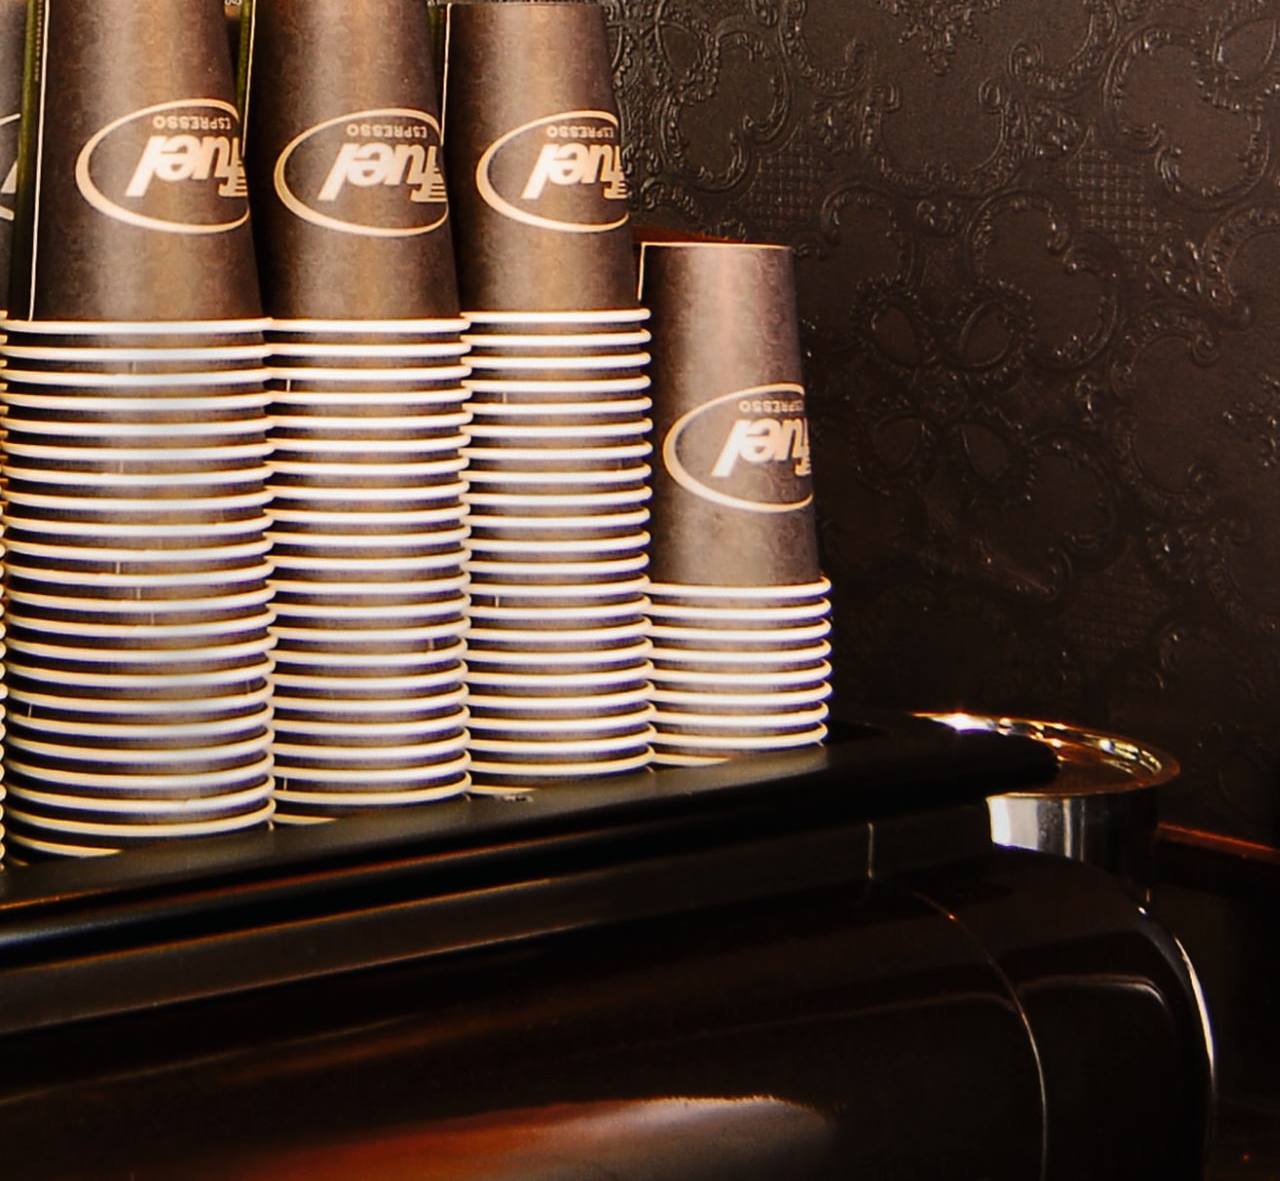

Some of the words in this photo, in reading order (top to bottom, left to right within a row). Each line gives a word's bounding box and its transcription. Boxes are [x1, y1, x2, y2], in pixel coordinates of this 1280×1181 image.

[153, 116, 231, 130] ESPRESSO
[346, 124, 428, 139] ESPRESSO
[125, 135, 248, 198] fuel
[317, 143, 447, 203] fuel
[520, 143, 629, 203] fuel
